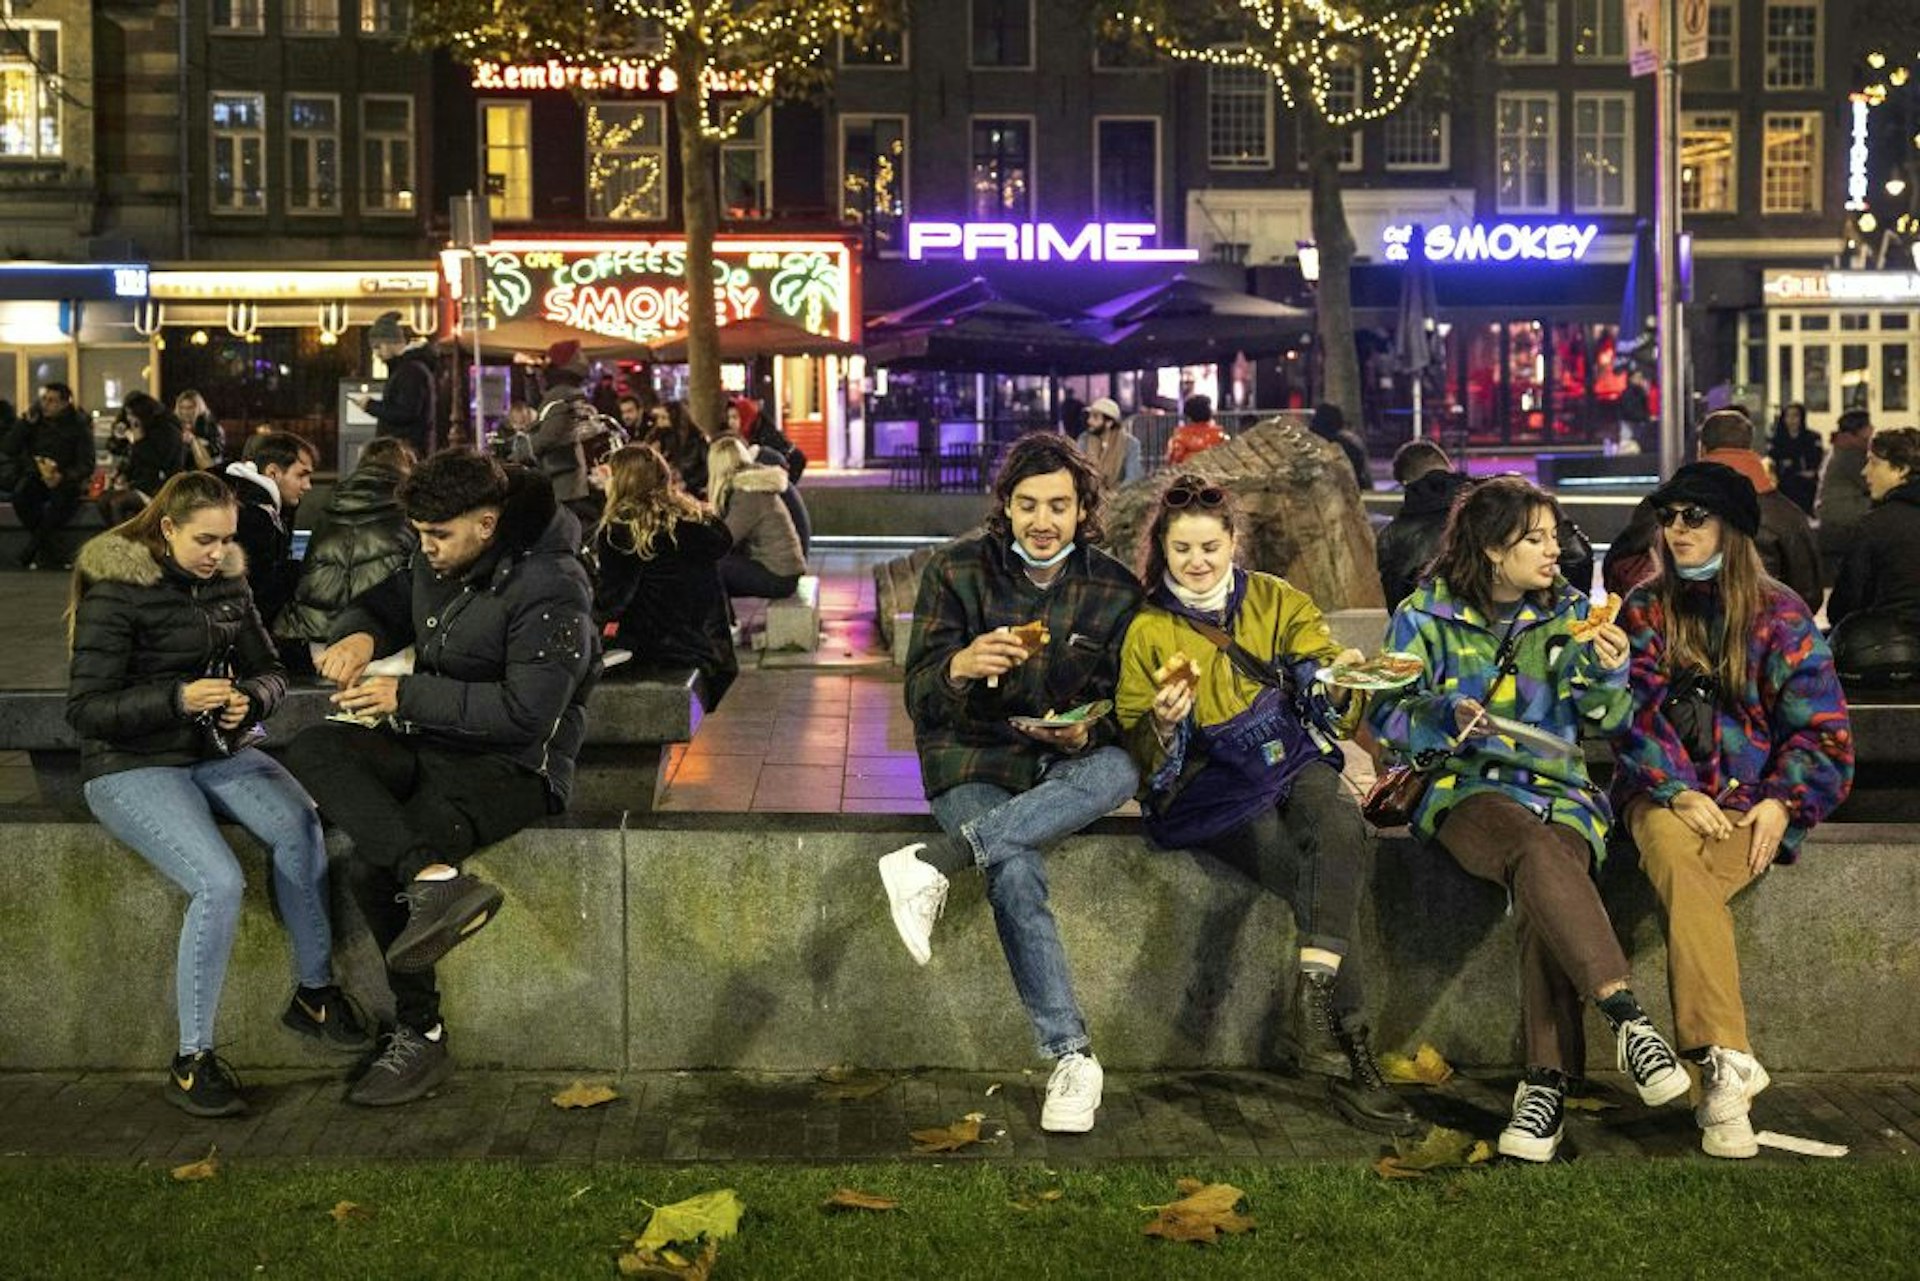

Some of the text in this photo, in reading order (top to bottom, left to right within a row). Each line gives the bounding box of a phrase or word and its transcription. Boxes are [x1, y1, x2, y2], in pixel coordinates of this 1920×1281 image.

[908, 222, 1199, 262] PRIME
[1424, 223, 1598, 261] SMOKEY
[553, 250, 750, 290] COFFEESOP
